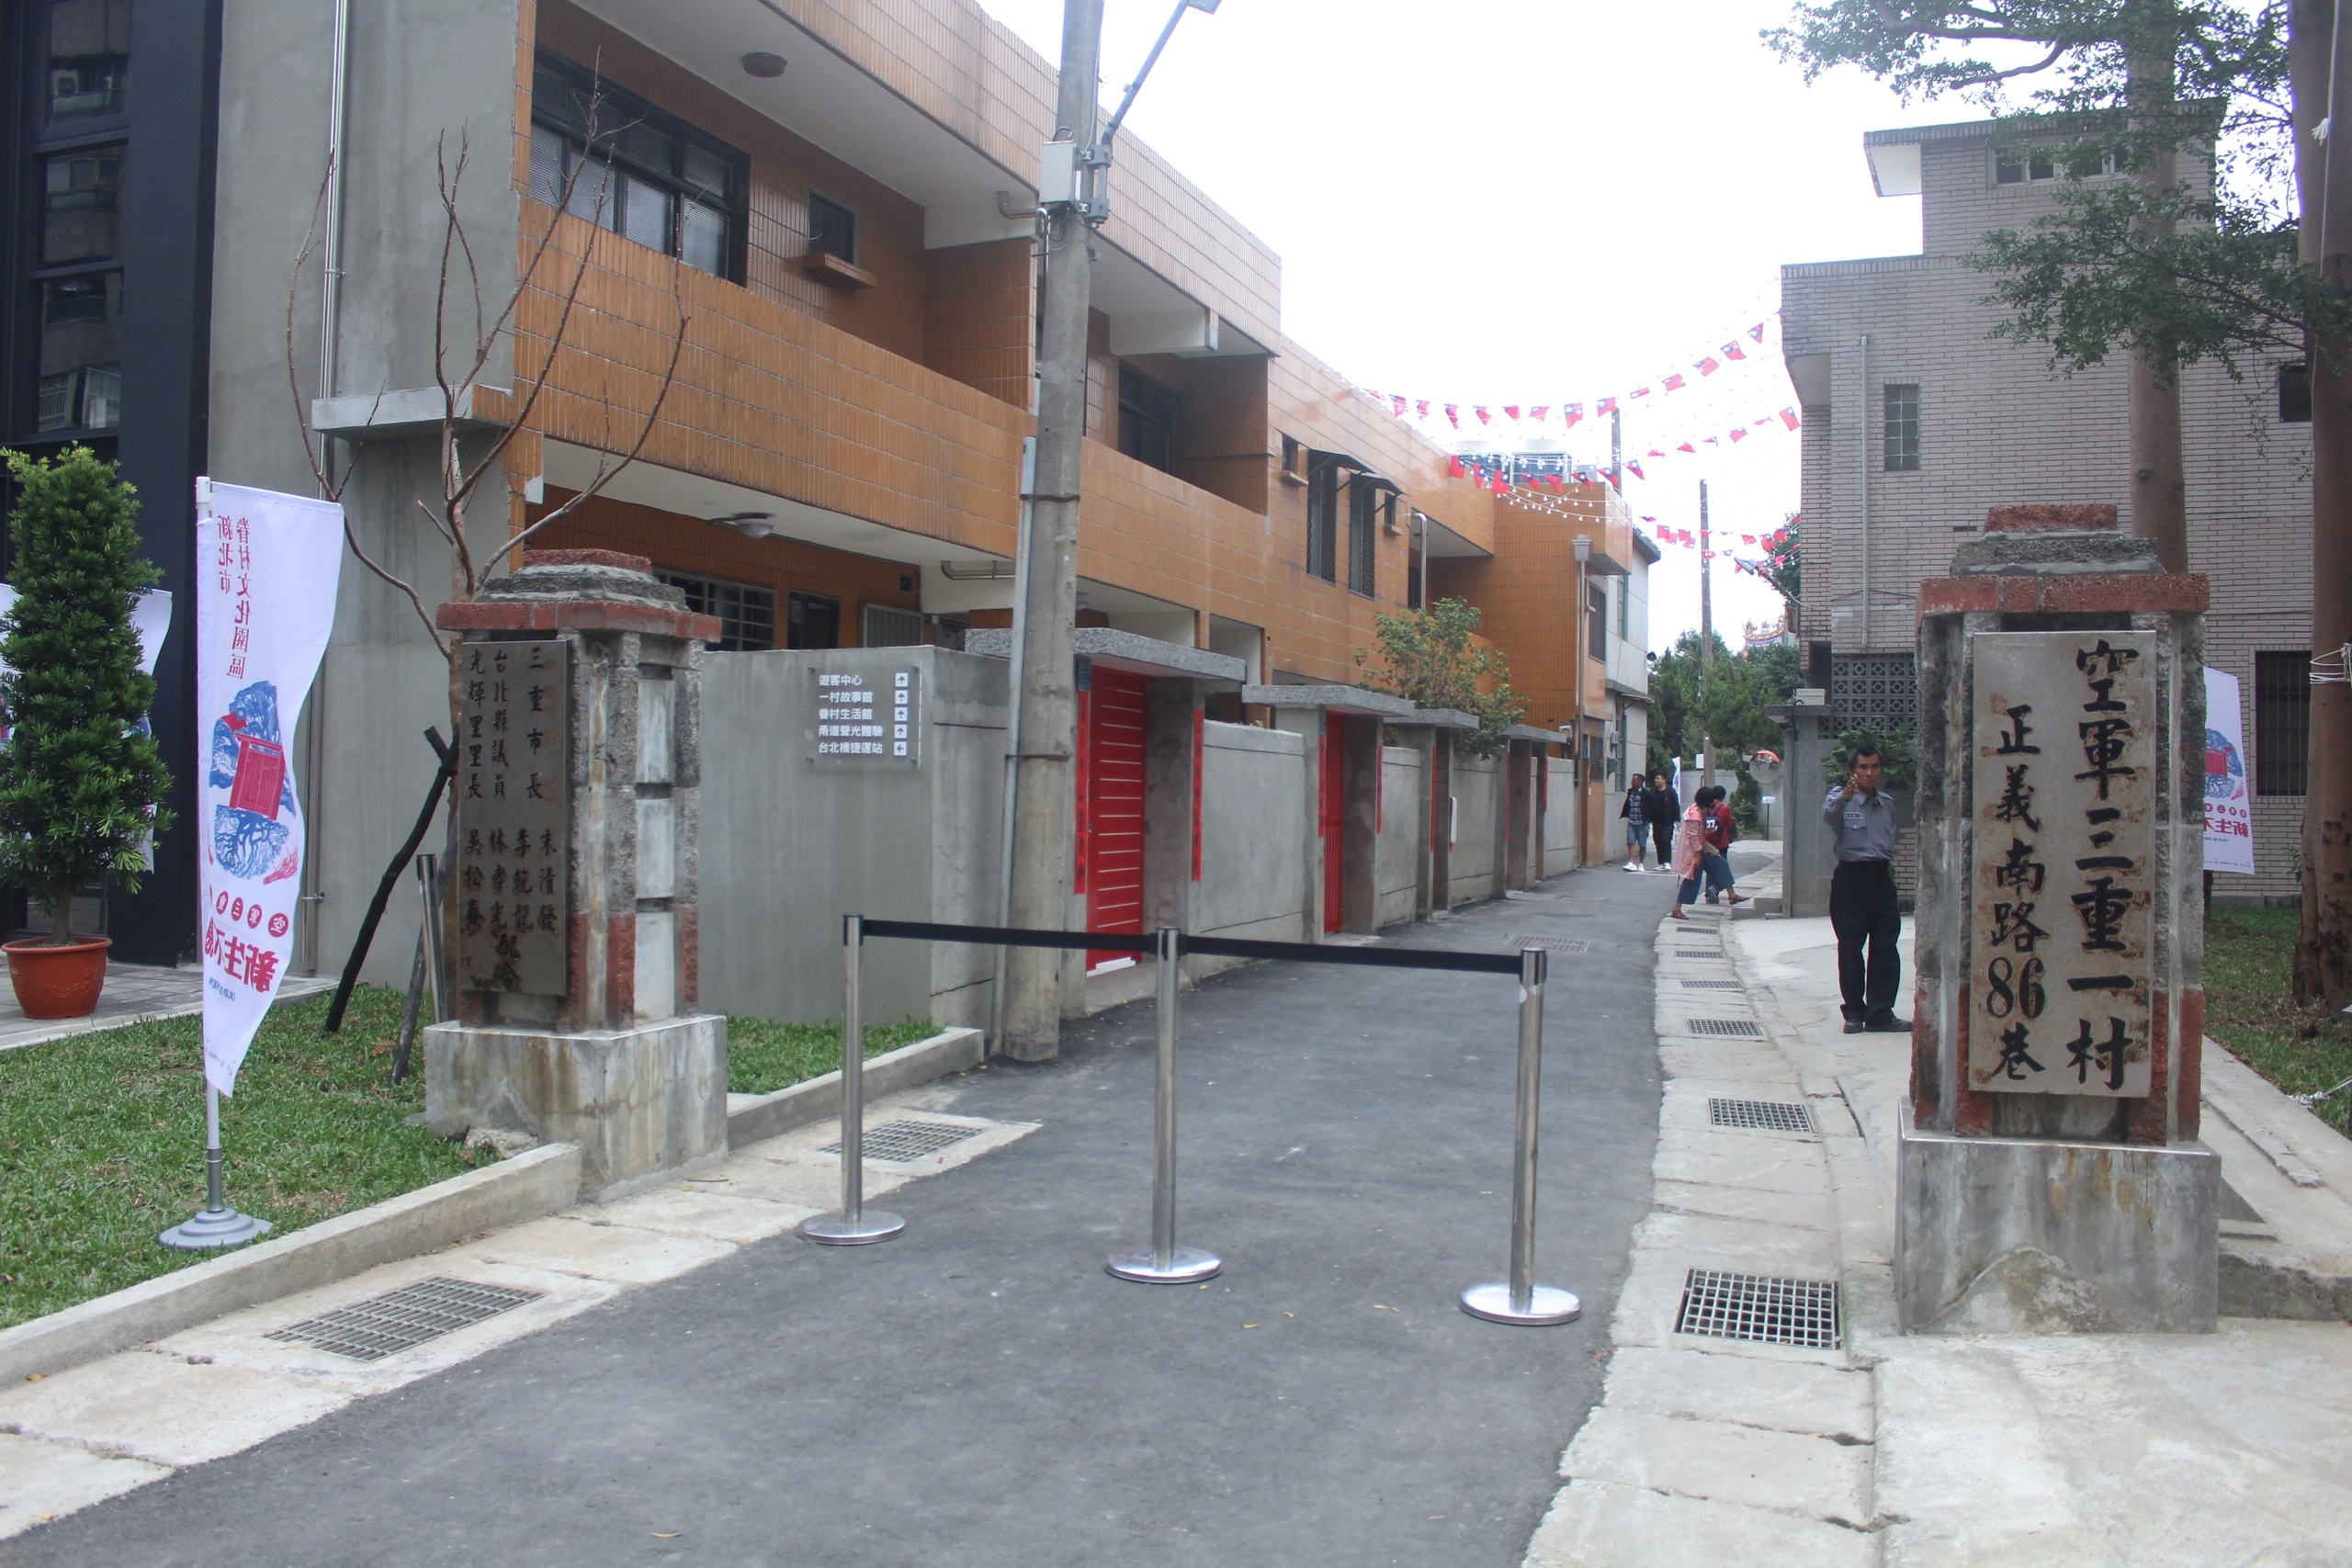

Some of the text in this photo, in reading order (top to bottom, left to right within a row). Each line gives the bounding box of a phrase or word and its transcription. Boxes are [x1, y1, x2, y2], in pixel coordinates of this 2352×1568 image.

[819, 674, 863, 686] 遊客中心
[819, 691, 873, 703] 一村故事館
[819, 708, 873, 720] 眷村生活館
[467, 648, 486, 799] 光輝里里長
[492, 649, 509, 799] 台北縣議員
[526, 646, 545, 799] 三重市長
[819, 725, 883, 737] 甬道聲光體驗
[819, 741, 883, 754] 台北橋捷運站
[1984, 703, 2052, 1081] 正義南路86巷
[2064, 638, 2140, 1091] 空軍三重一村
